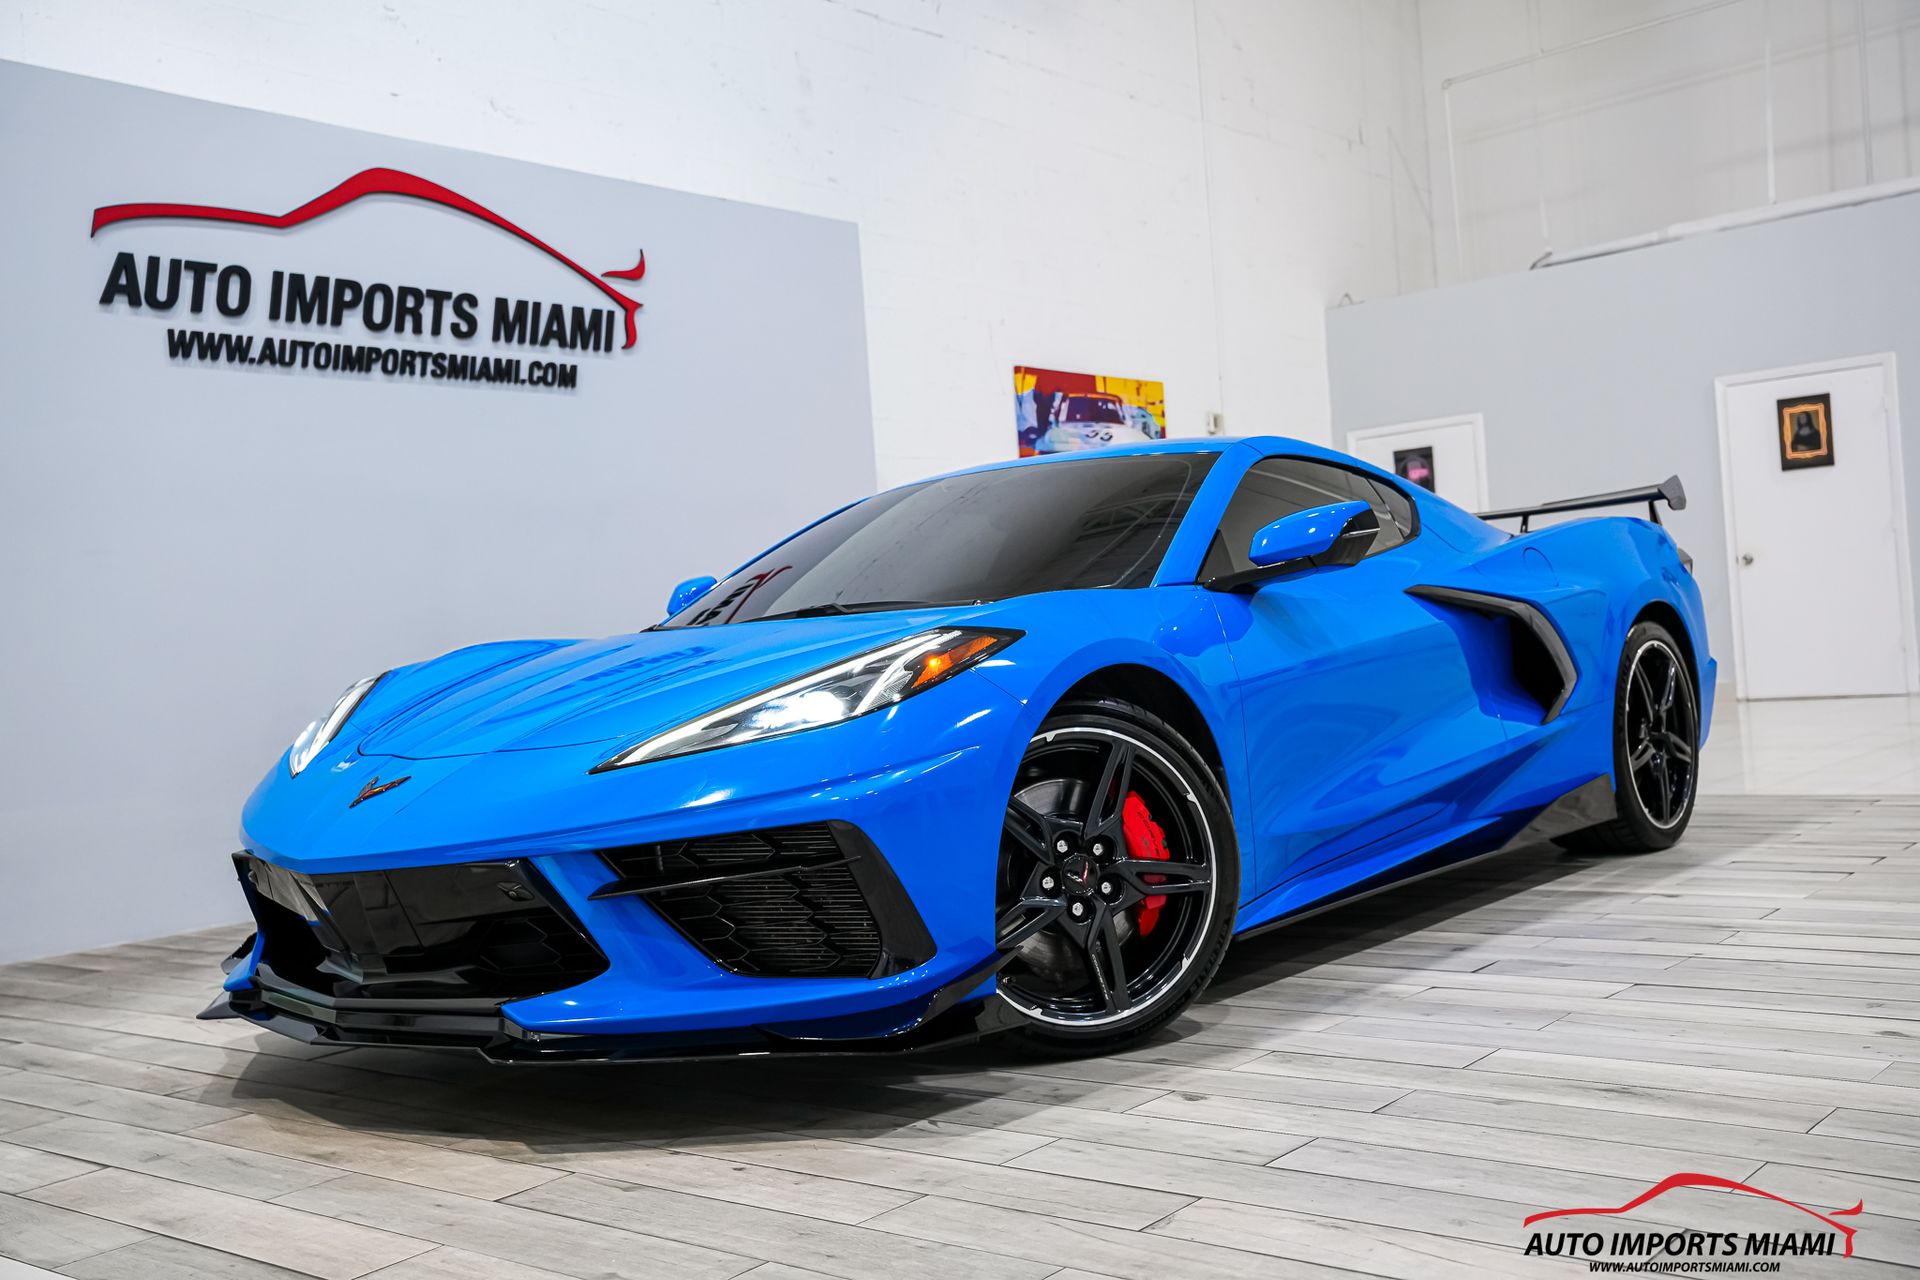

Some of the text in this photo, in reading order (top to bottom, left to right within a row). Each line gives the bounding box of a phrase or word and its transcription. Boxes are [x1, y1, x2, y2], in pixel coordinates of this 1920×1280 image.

[99, 252, 615, 353] AUTO IMPORTS MIAMI
[167, 328, 578, 389] WWW.AUTOIMPORTSMIAMI.COM
